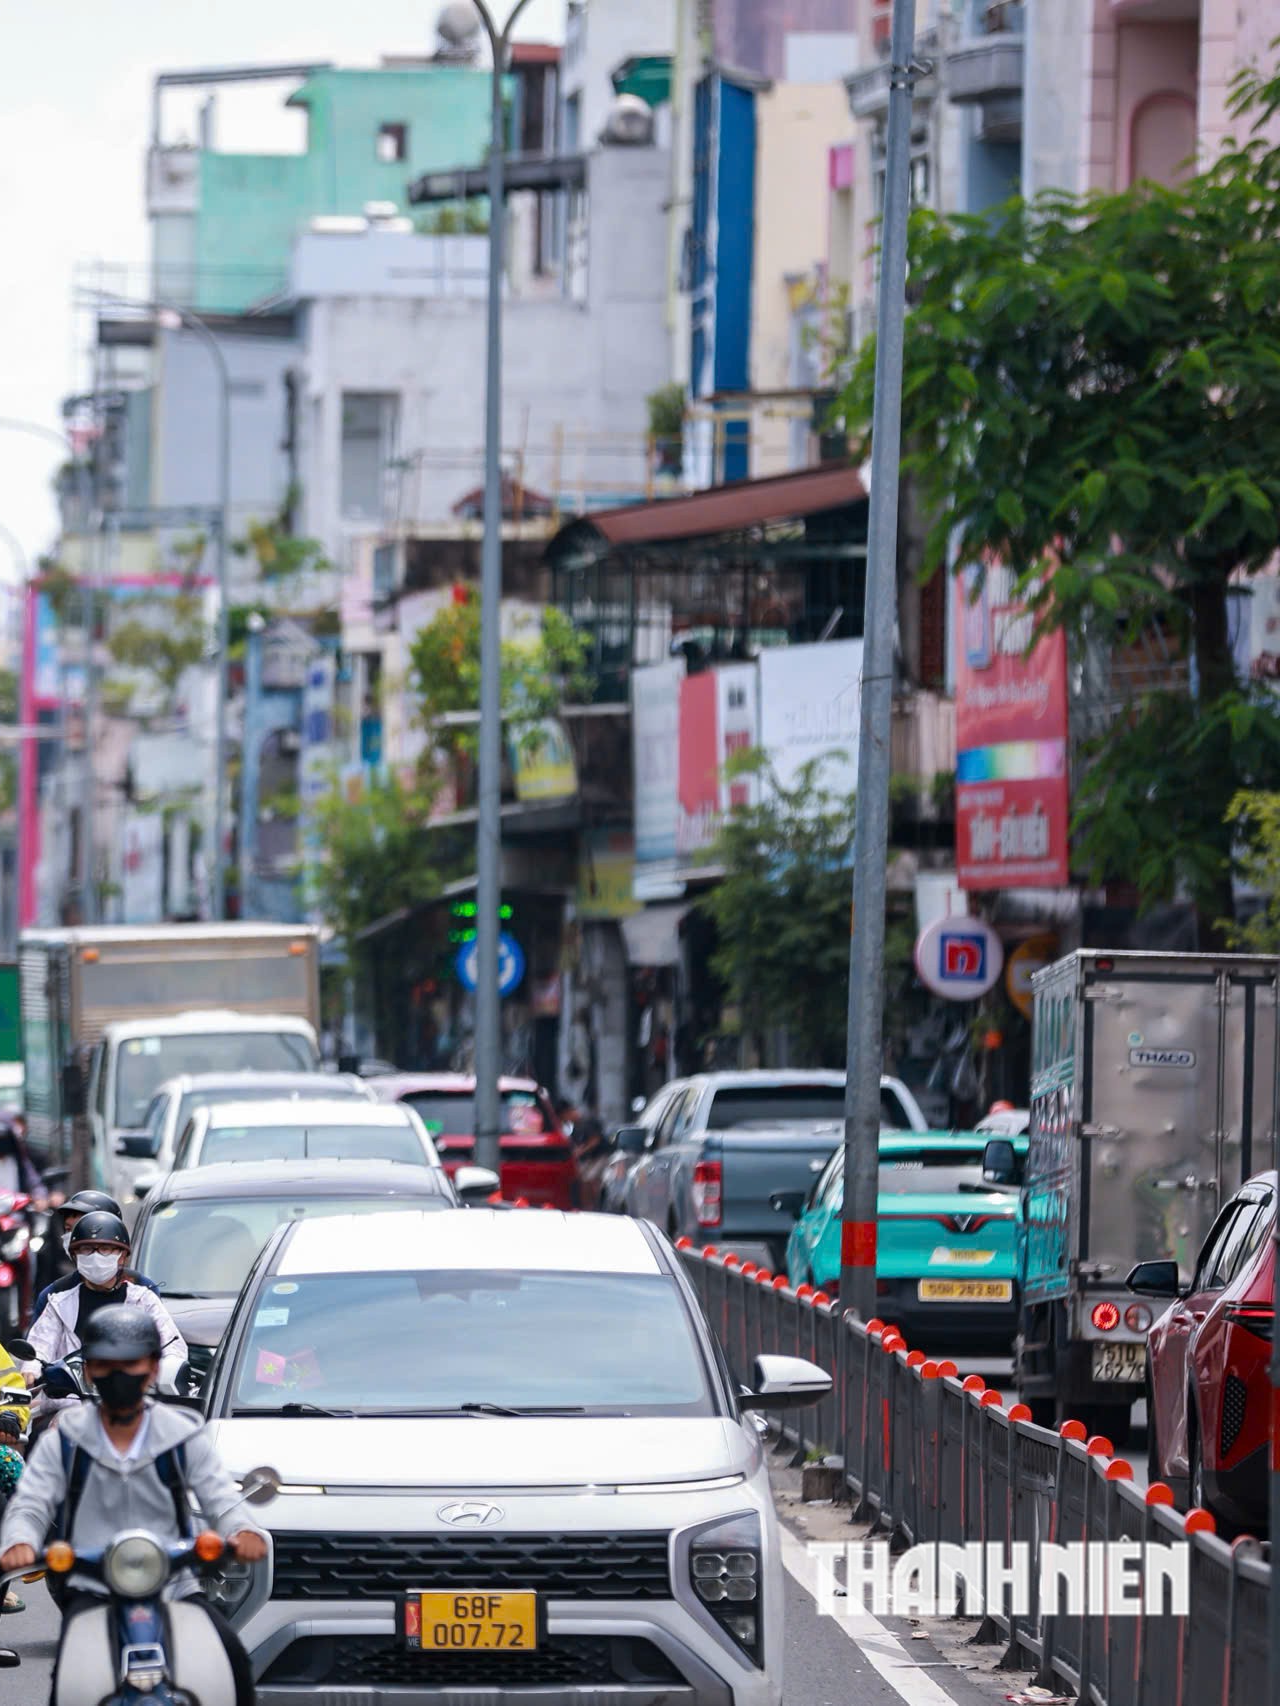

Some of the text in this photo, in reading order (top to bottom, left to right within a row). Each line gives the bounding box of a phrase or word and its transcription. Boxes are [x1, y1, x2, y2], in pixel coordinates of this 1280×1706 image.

[1136, 1051, 1191, 1065] THACO
[453, 1596, 503, 1619] 68F
[407, 1638, 420, 1647] VIE
[433, 1624, 524, 1647] 007.72
